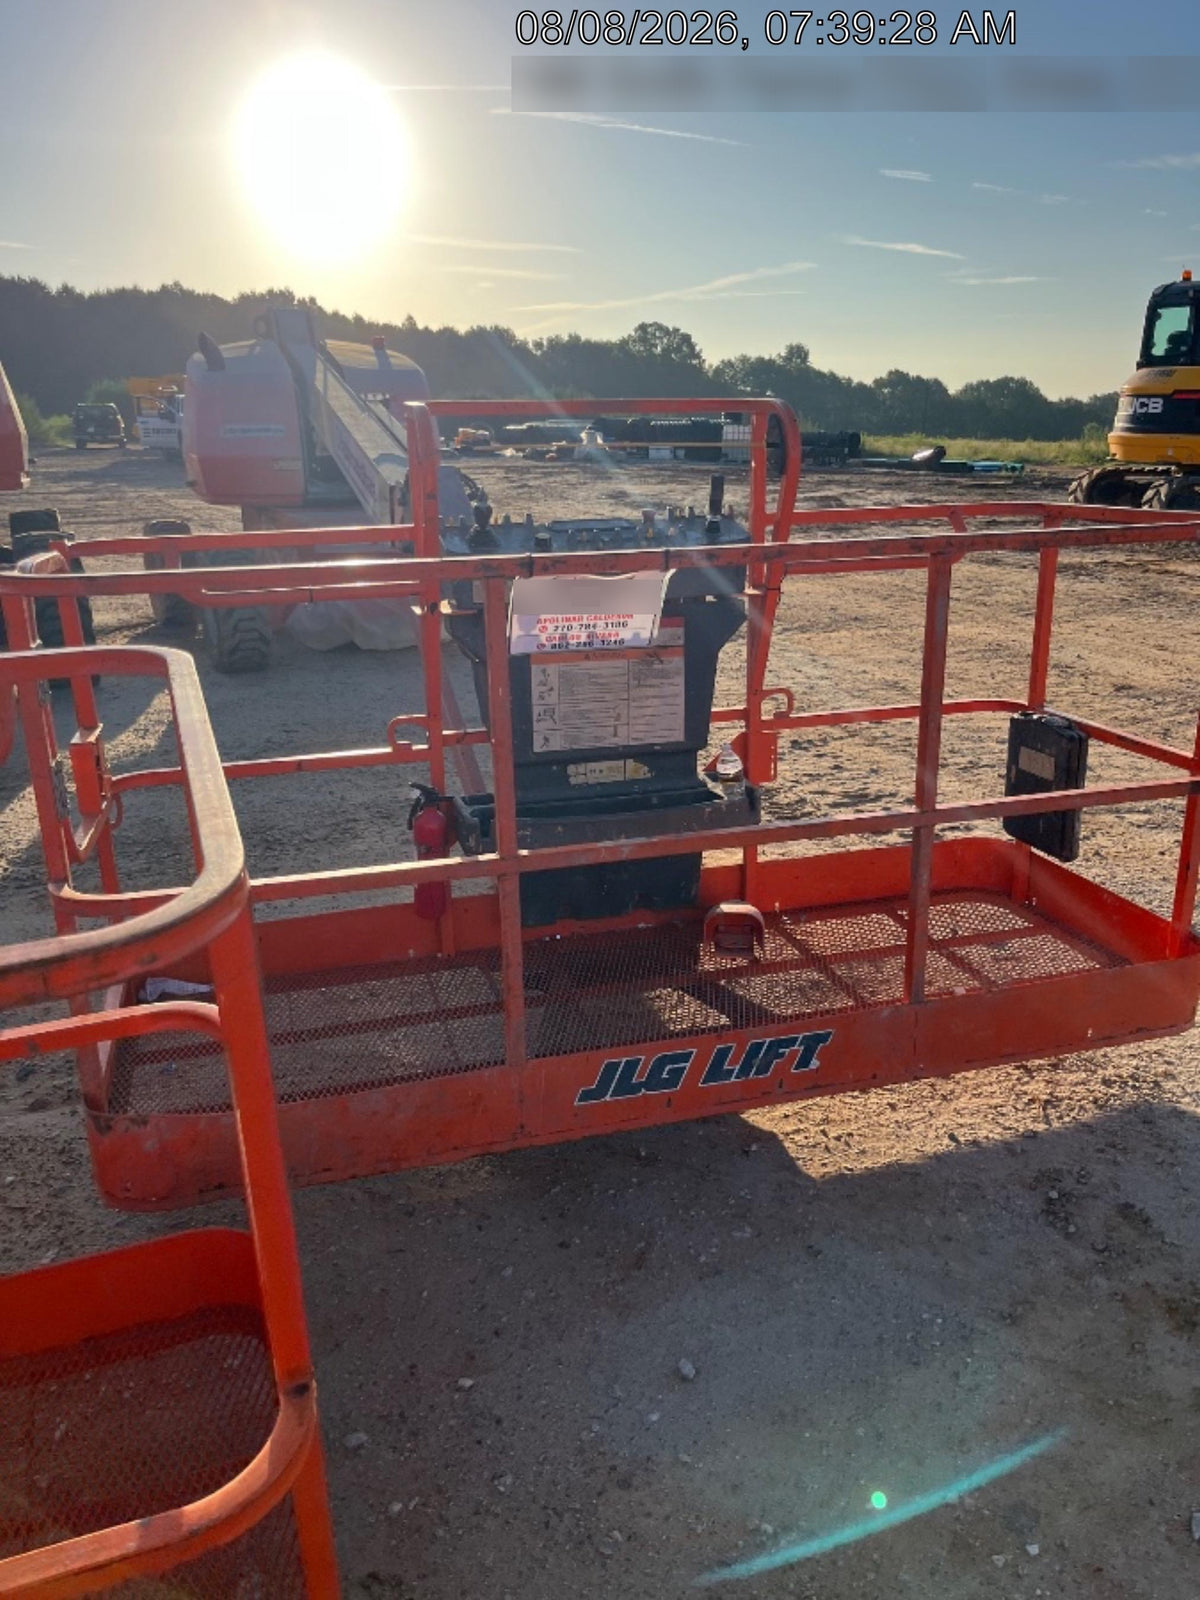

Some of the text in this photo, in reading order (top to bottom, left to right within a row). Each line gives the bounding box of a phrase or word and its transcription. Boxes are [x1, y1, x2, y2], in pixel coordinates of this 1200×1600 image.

[1128, 398, 1163, 414] JCB
[574, 1029, 834, 1106] JLG LIFT
